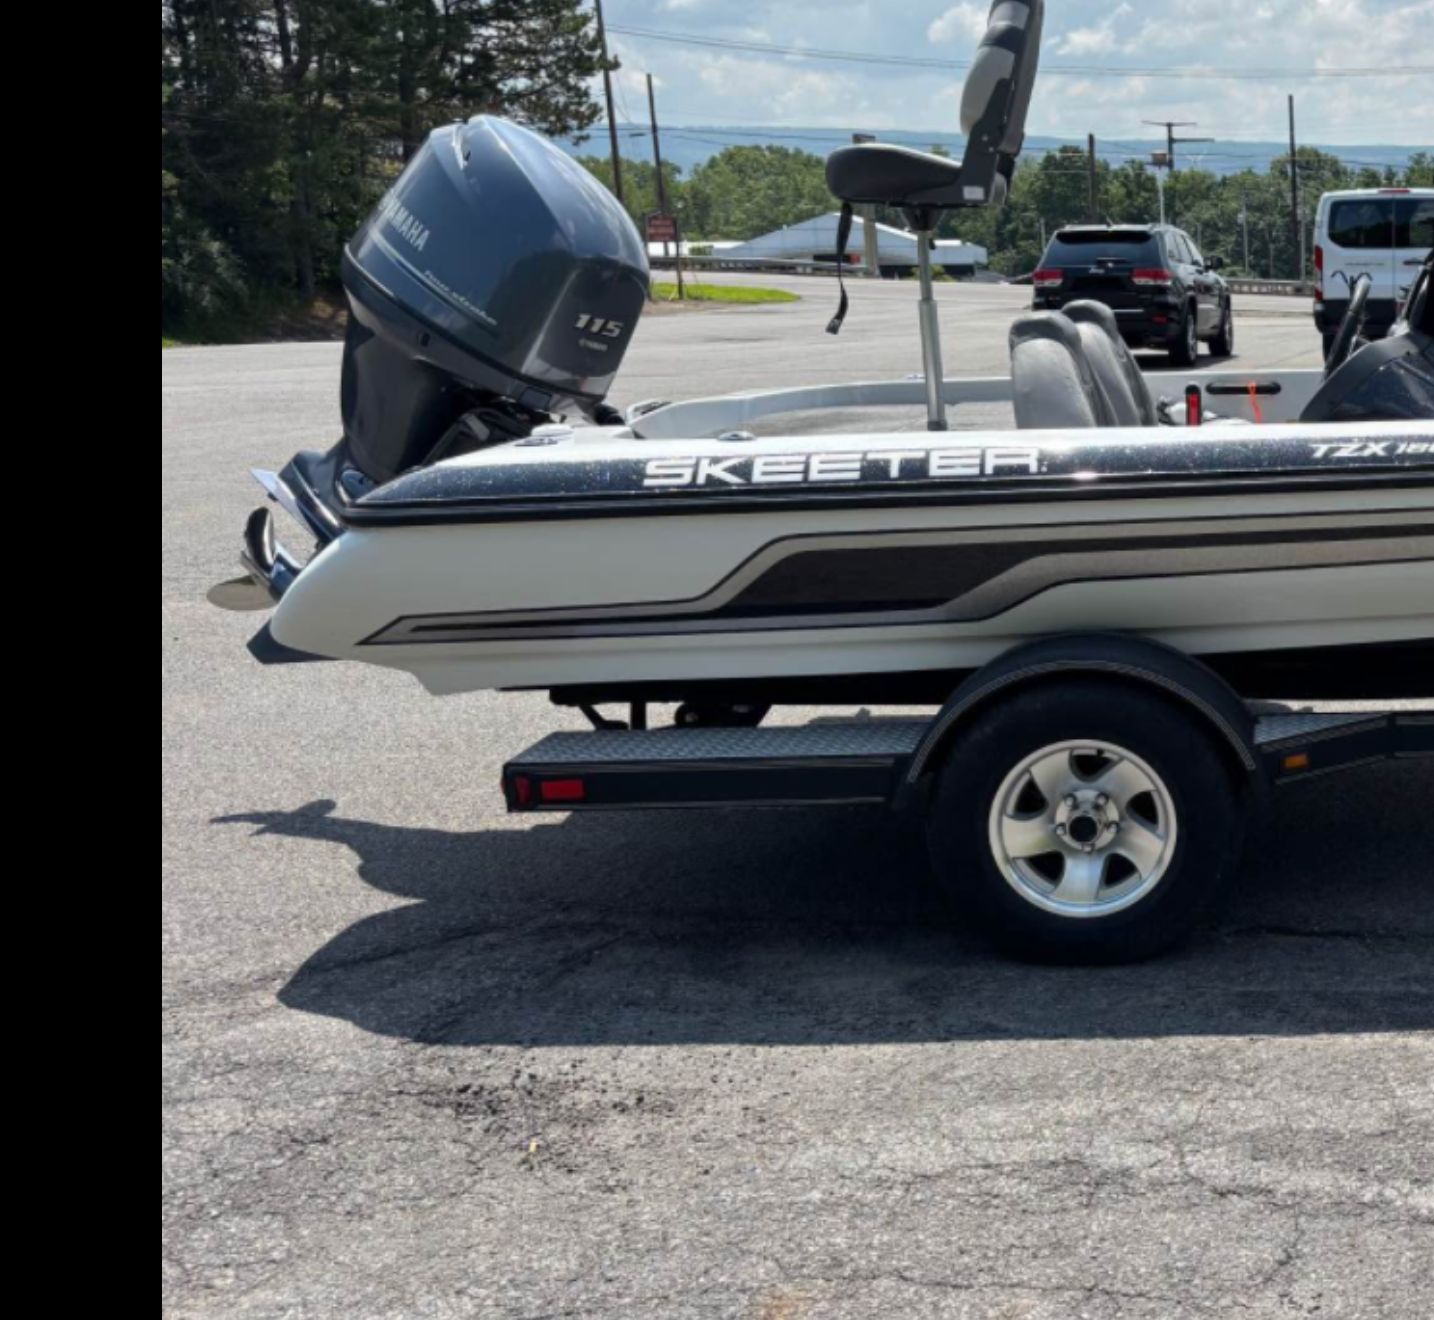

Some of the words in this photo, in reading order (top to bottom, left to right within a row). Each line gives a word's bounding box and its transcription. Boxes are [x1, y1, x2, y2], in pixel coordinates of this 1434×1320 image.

[575, 314, 624, 338] 115
[1309, 441, 1391, 459] TZX
[642, 447, 1039, 487] SKEETER
